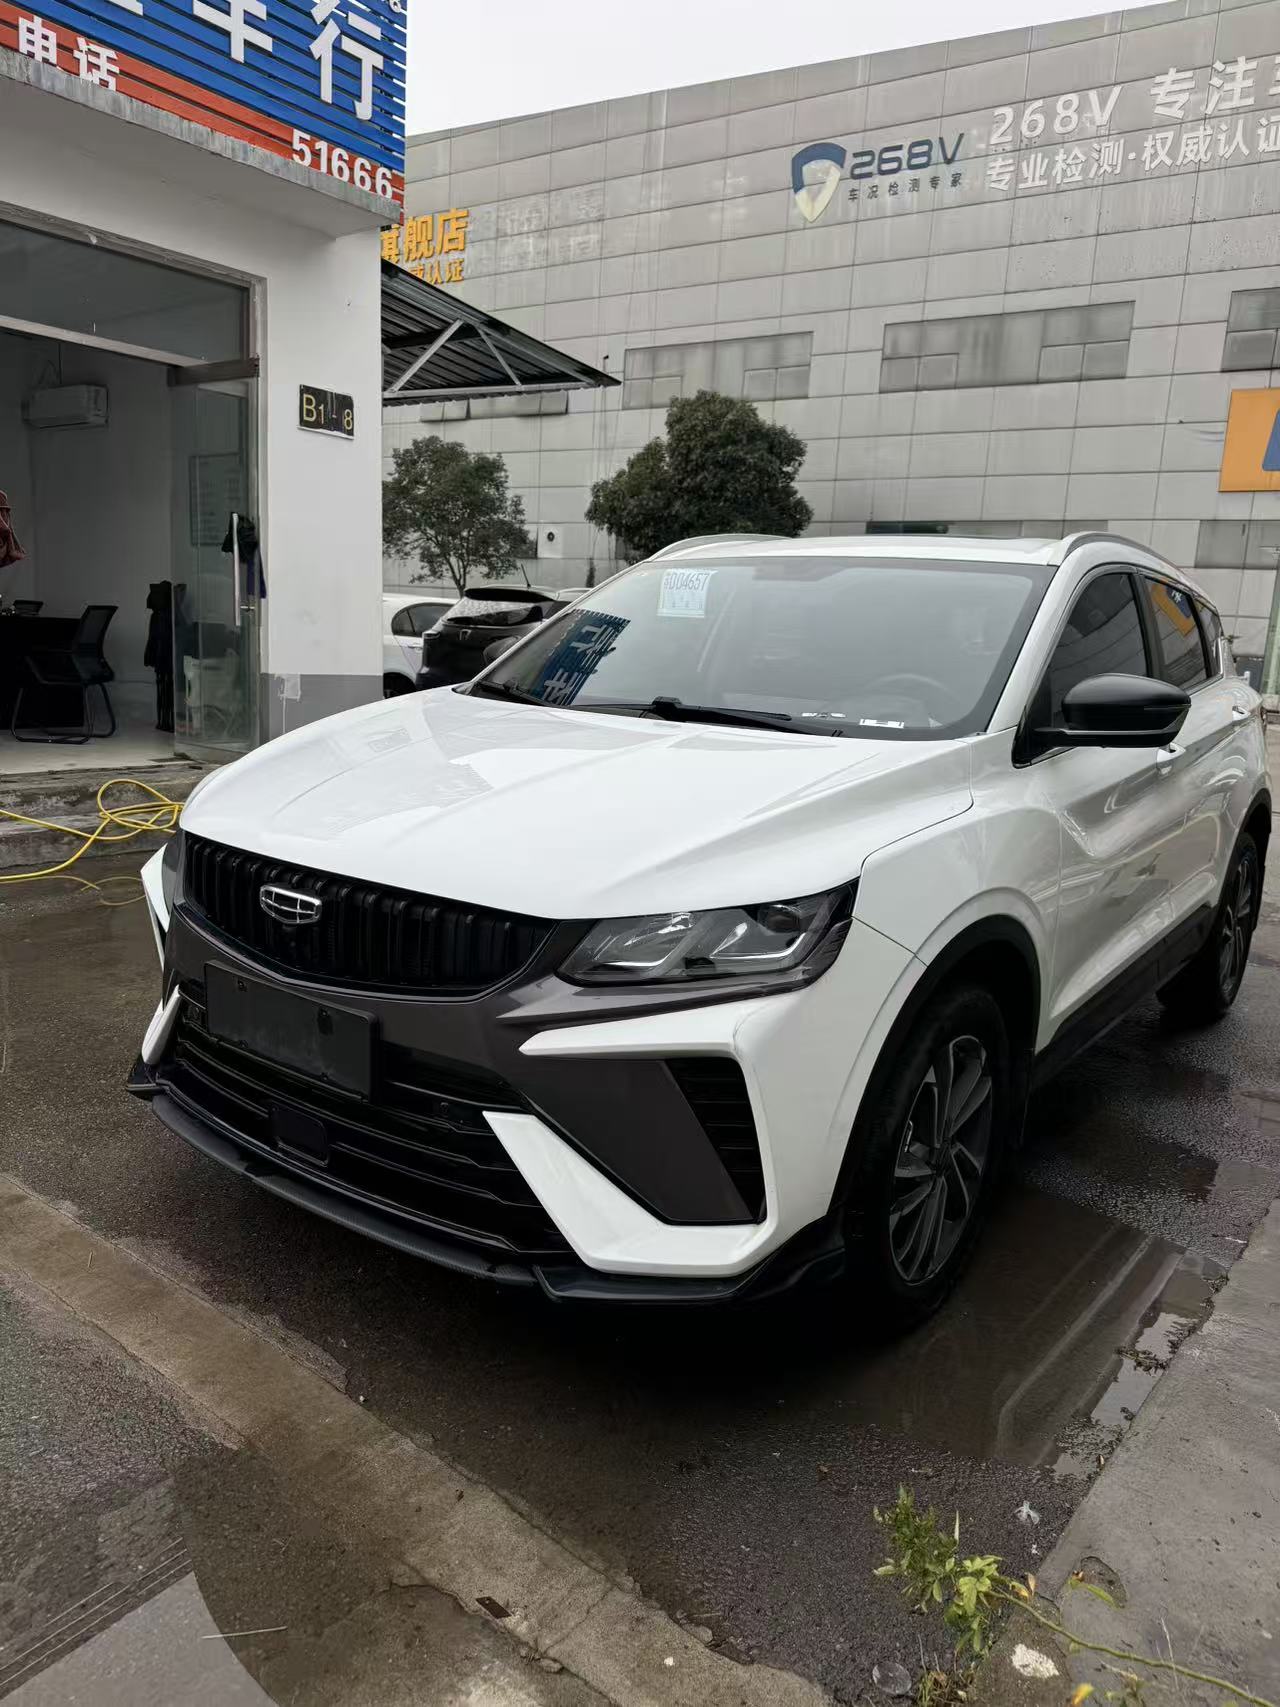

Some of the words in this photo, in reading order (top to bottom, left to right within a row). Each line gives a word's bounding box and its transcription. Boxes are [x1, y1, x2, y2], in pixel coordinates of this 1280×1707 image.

[19, 14, 119, 92] 电话
[293, 128, 393, 200] 51666
[989, 84, 1123, 146] 268V
[1149, 56, 1280, 119] 专注
[850, 132, 965, 181] 268V
